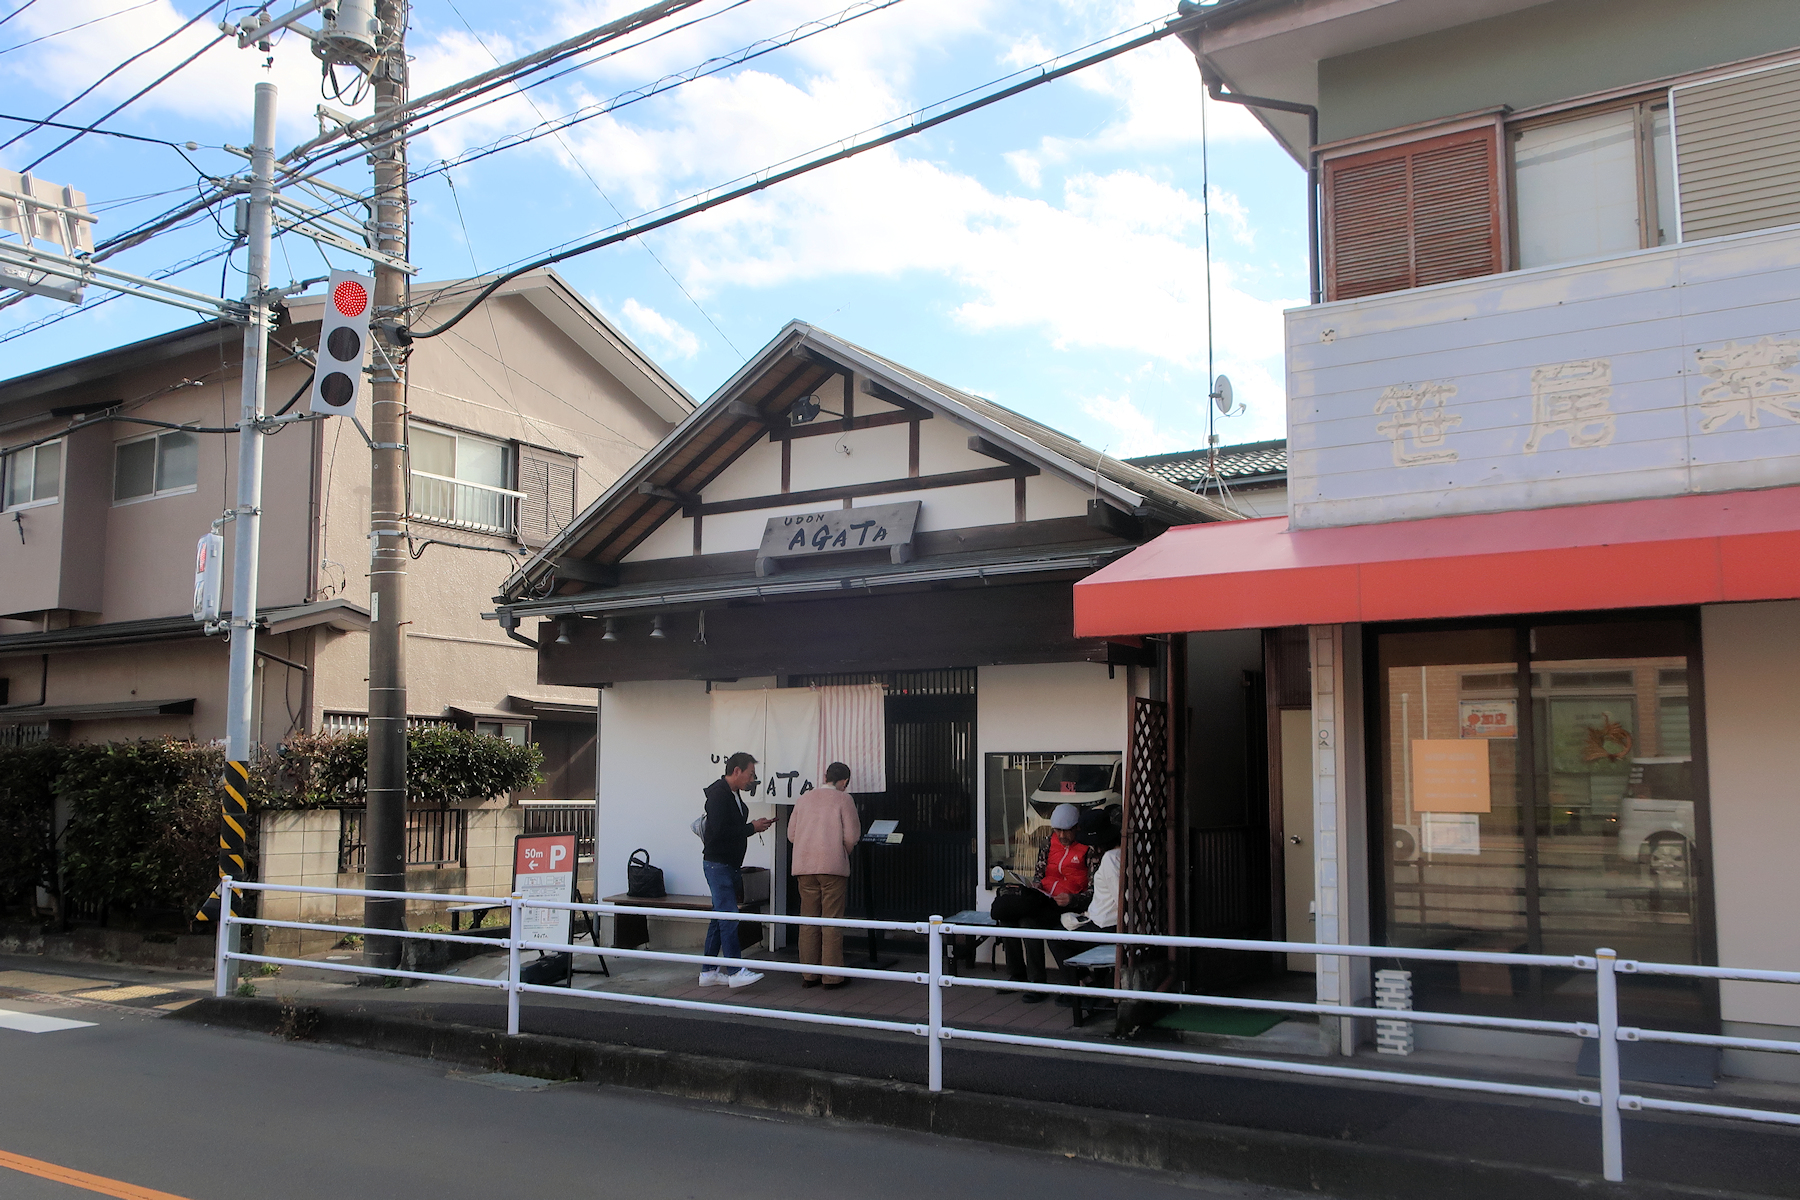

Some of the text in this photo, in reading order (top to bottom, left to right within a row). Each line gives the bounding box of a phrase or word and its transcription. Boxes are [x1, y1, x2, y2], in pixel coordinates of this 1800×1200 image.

[784, 514, 825, 526] UDON
[788, 520, 888, 551] AGATA
[524, 844, 567, 870] 50m P
